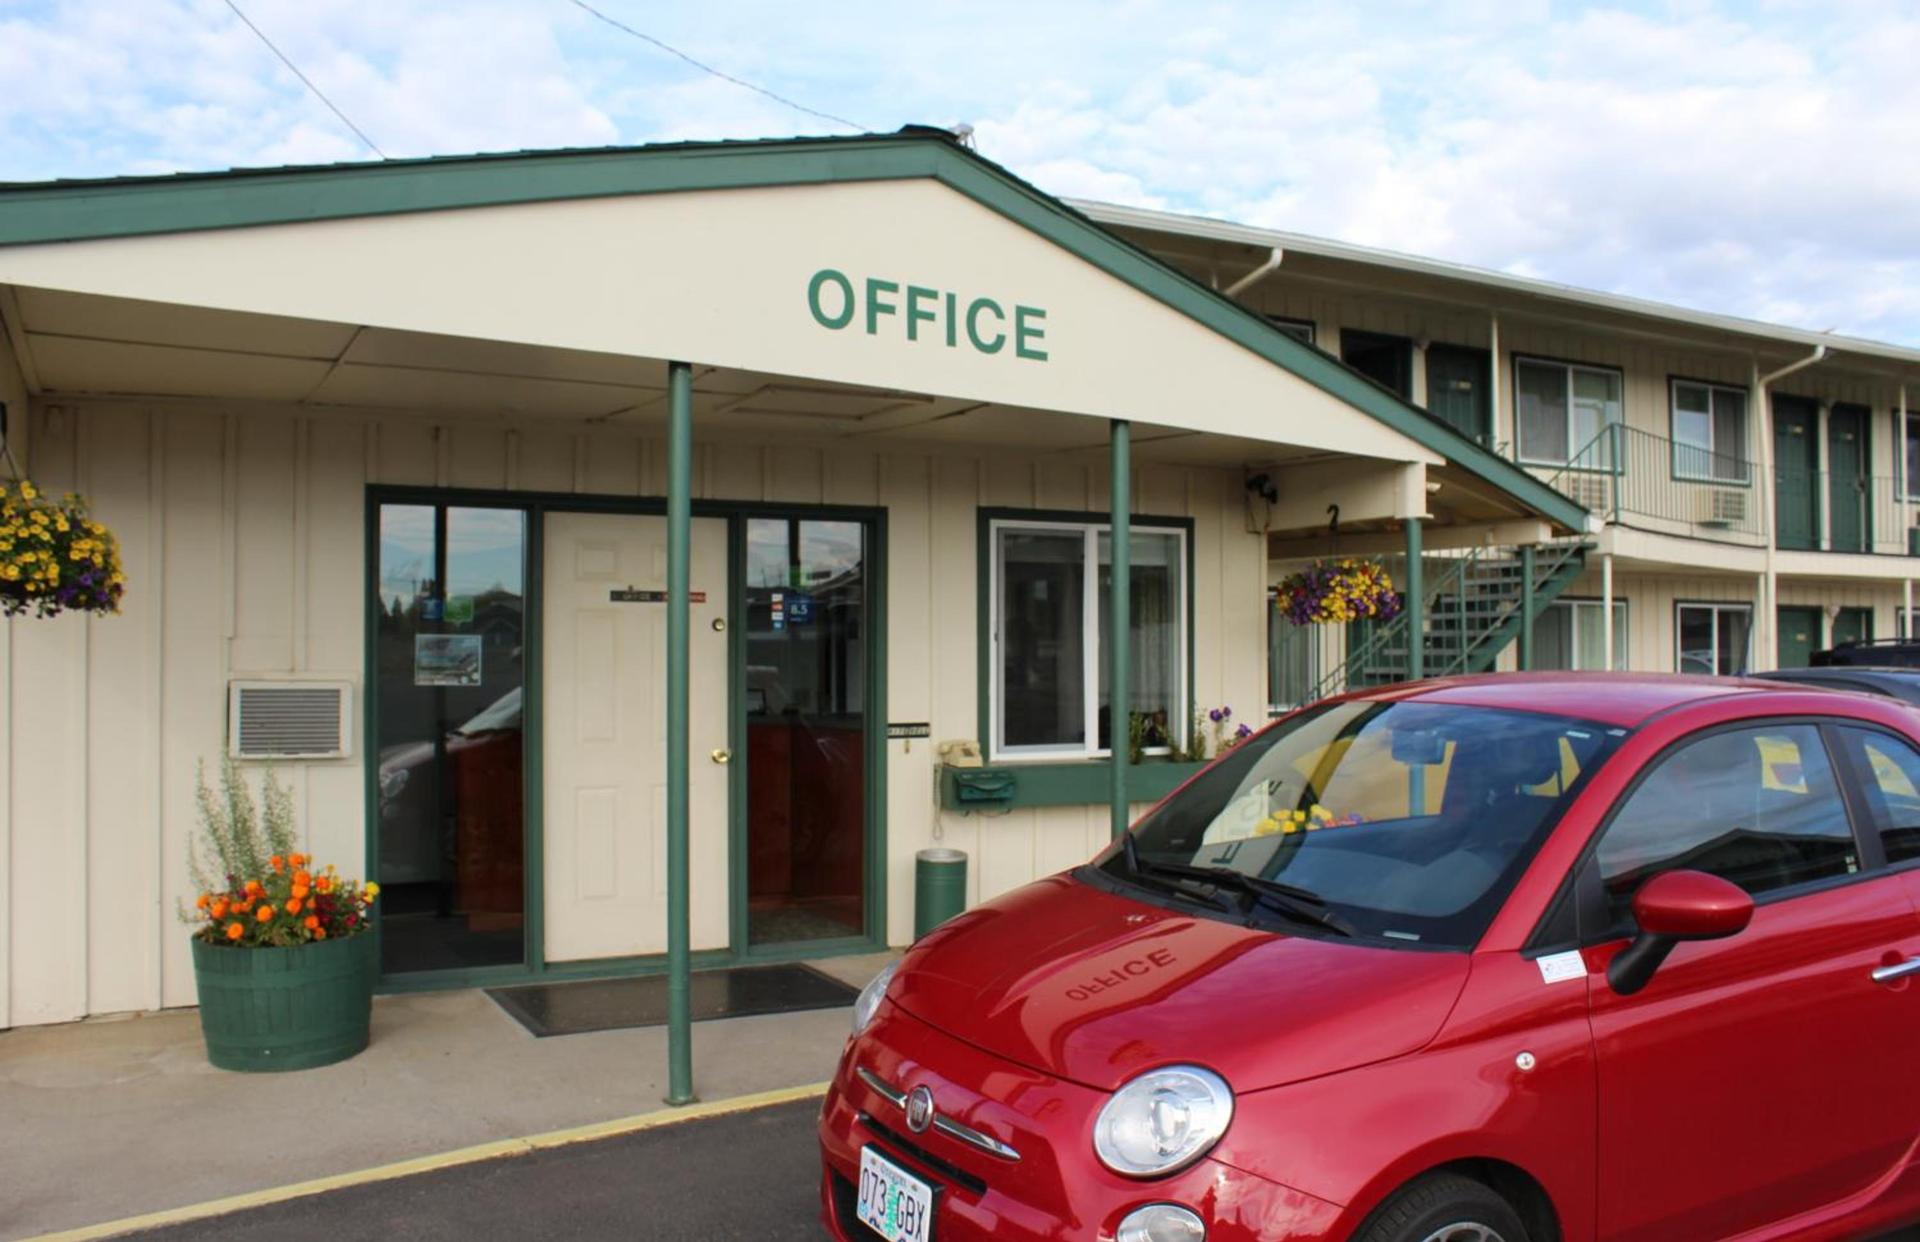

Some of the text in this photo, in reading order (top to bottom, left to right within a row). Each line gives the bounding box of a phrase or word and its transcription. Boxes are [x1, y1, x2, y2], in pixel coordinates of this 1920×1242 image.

[807, 268, 1049, 362] OFFICE
[861, 1167, 887, 1217] 073
[896, 1190, 925, 1242] GBX
